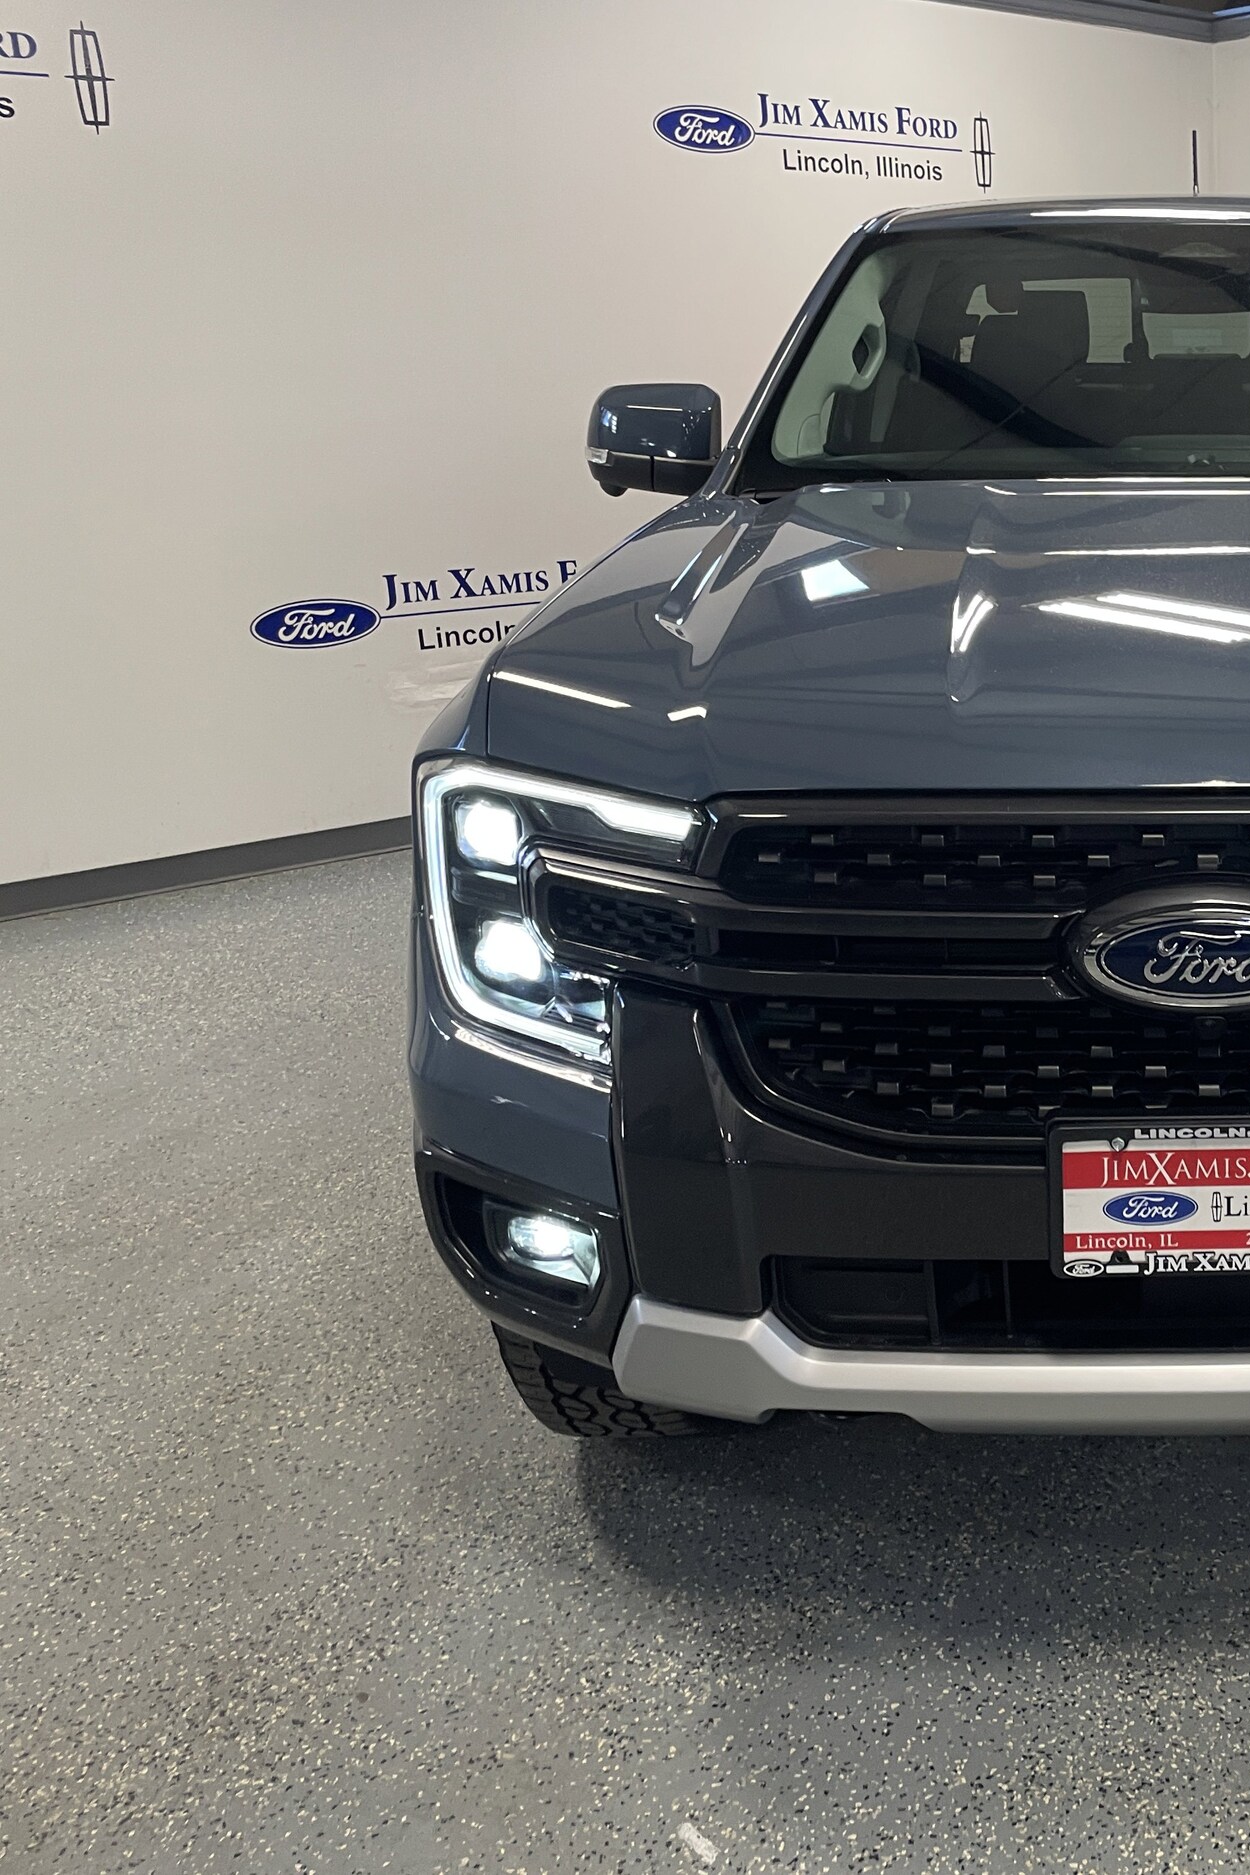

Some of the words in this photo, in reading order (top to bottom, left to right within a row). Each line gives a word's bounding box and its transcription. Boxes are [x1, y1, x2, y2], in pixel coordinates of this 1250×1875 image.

[674, 113, 735, 146] Ford
[757, 93, 801, 128] JIM
[808, 98, 888, 134] XAMIS
[895, 106, 958, 139] FORD
[783, 149, 870, 179] Lincoln,
[876, 156, 943, 181] Illinois
[382, 573, 439, 611] JIM
[448, 568, 549, 599] XAMIS
[278, 608, 355, 642] Ford
[1122, 1196, 1178, 1218] Ford
[1076, 1234, 1152, 1249] Lincoln,
[1160, 1234, 1178, 1247] IL
[1143, 1253, 1189, 1275] JIM
